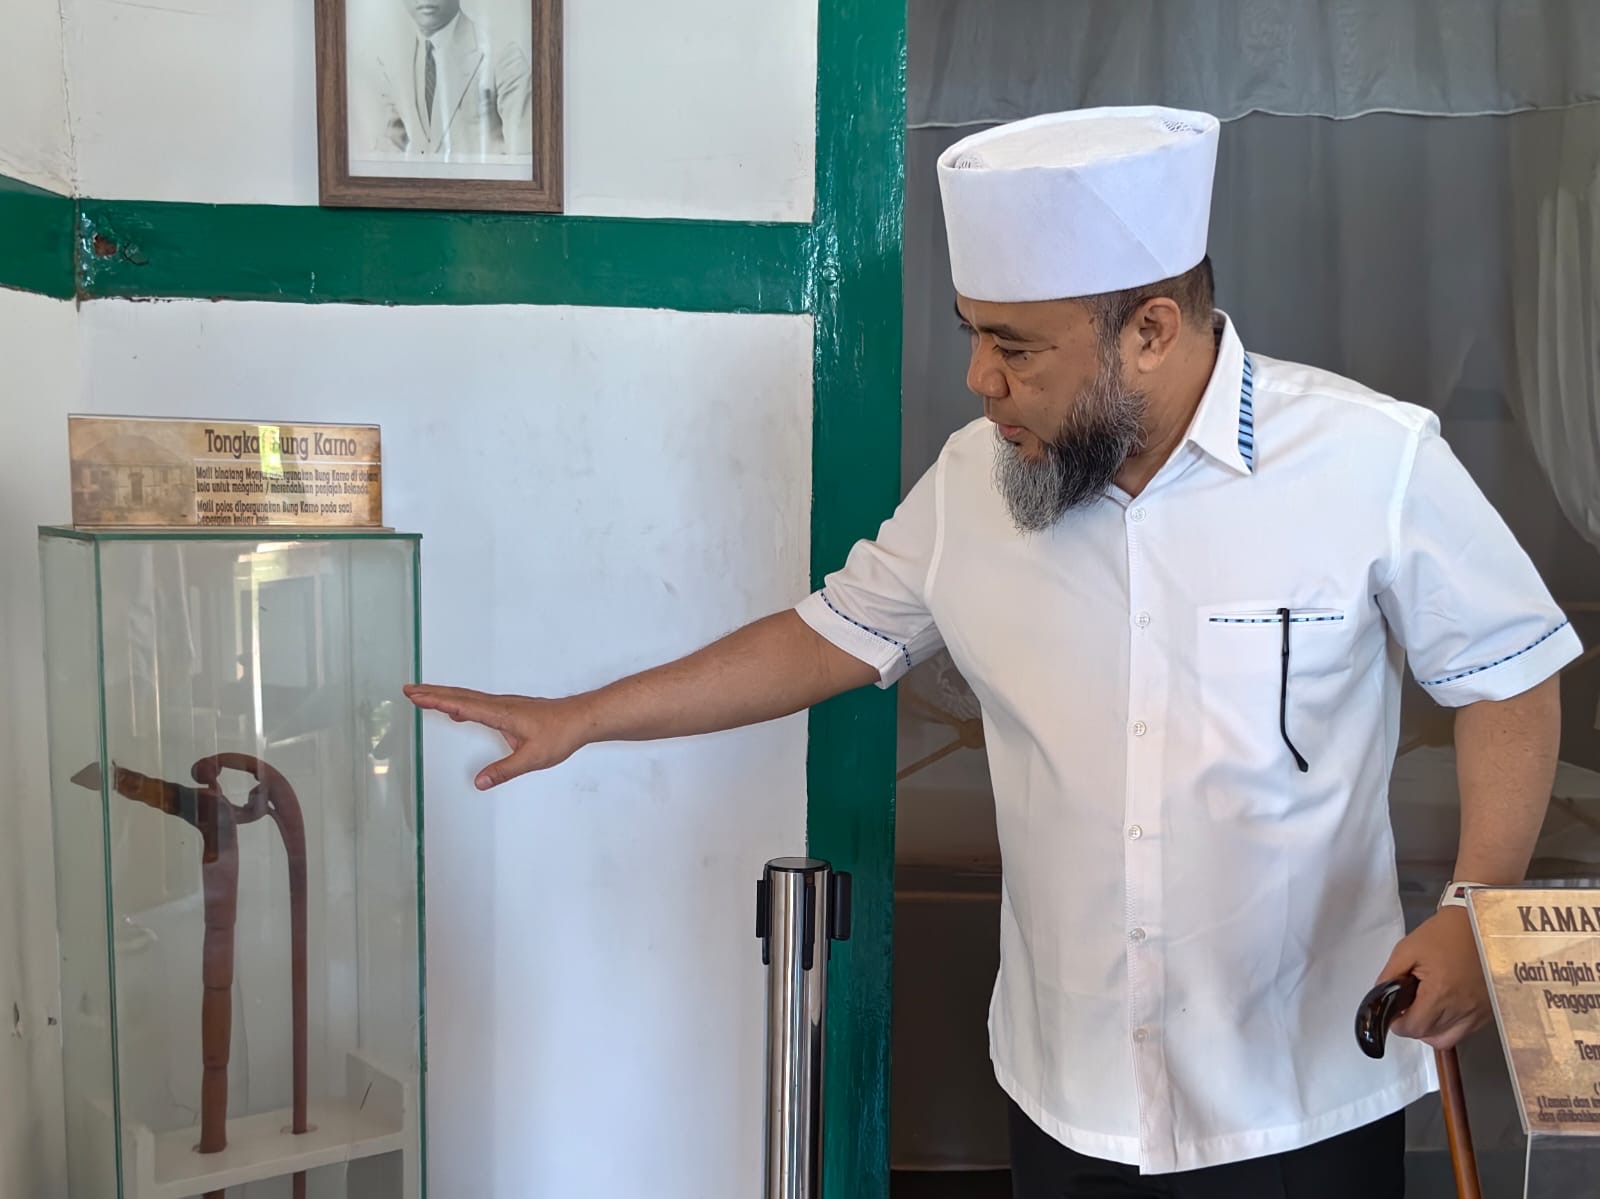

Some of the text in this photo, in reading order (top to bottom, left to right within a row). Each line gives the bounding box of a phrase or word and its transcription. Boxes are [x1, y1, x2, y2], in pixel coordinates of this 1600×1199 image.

[204, 429, 357, 460] Tongka ung Karno
[214, 467, 244, 482] binatang
[315, 468, 331, 484] Bung
[332, 469, 350, 482] Karno
[351, 469, 358, 482] di
[212, 480, 230, 493] untuk
[232, 481, 264, 496] menghina
[271, 481, 314, 495] merendahkan
[315, 482, 342, 497] penjajah
[215, 500, 233, 516] polos
[235, 500, 281, 516] dipergunakan
[282, 500, 299, 517] Bung
[300, 500, 319, 513] Karno
[320, 501, 337, 517] pada
[338, 501, 353, 514] saat
[1513, 960, 1549, 984] (dari
[1548, 960, 1595, 987] Hajjah
